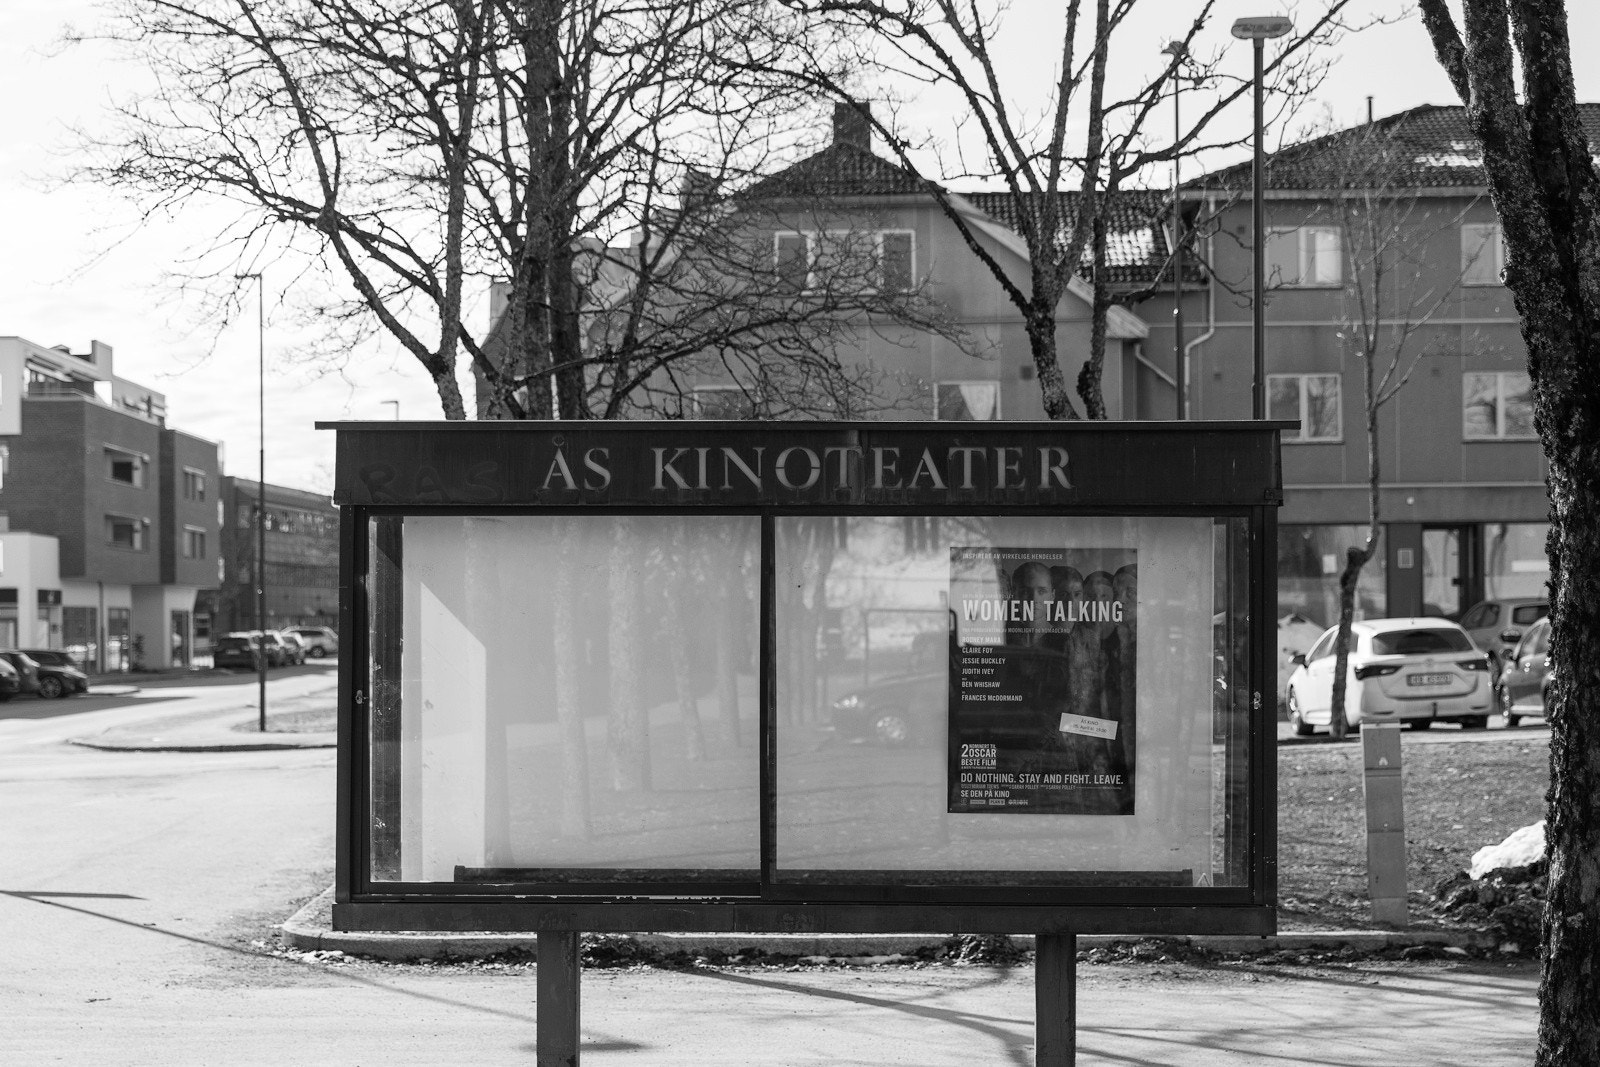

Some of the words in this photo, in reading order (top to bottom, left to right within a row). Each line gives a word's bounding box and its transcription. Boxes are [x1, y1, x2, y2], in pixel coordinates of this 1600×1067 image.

[541, 435, 612, 491] ÅS
[651, 446, 1074, 491] KINOTEATER
[963, 600, 1035, 622] WOMEN
[1044, 600, 1123, 623] TALKING
[962, 657, 980, 665] JESSIE
[981, 657, 1006, 665] BUCKLEY
[987, 694, 1023, 702] McDORMAND
[961, 743, 969, 758] 2
[968, 748, 997, 758] OSCAR
[961, 758, 981, 766] BESTE
[981, 758, 997, 766] FILM
[961, 773, 973, 783] DO
[975, 773, 1017, 784] NOTHING.
[1018, 773, 1041, 784] STAY
[1043, 774, 1062, 784] AND
[1064, 774, 1092, 785] FIGHT.
[1094, 774, 1124, 785] LEAVE.
[960, 790, 969, 798] SE
[970, 790, 983, 798] DEN
[984, 788, 993, 798] PÅ
[994, 790, 1010, 798] KINO
